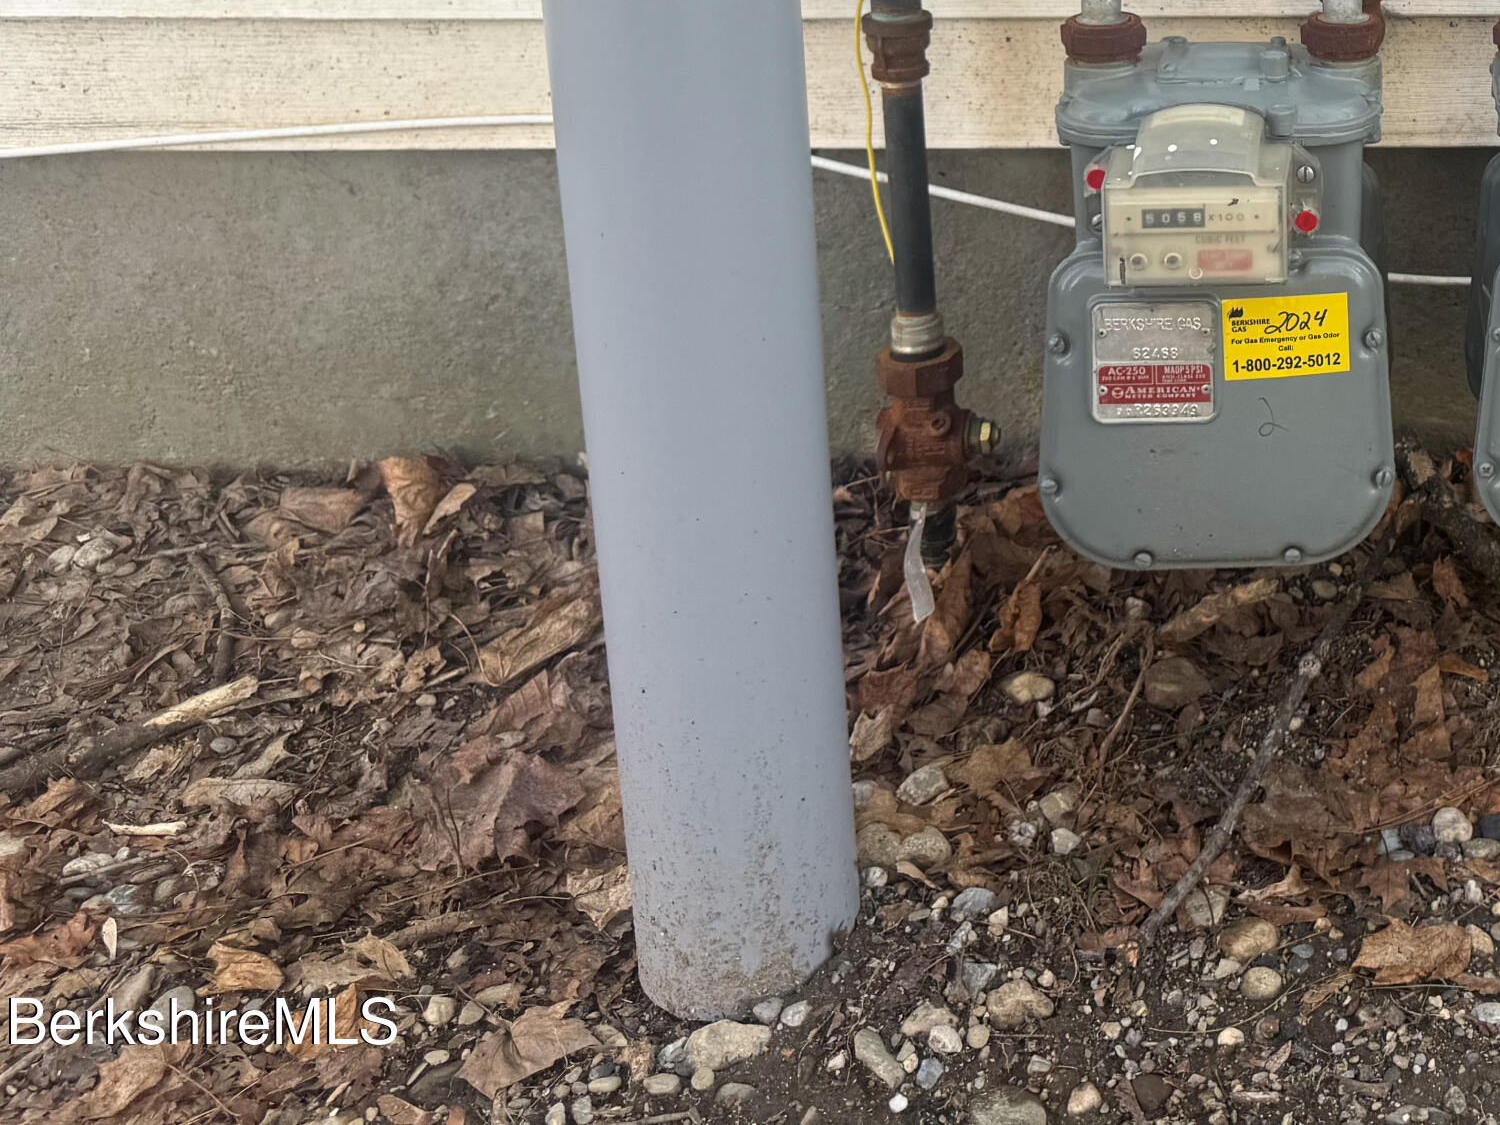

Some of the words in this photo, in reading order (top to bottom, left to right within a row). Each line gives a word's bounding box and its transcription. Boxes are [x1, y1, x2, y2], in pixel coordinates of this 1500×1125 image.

[1195, 235, 1222, 245] CUBIC
[1225, 234, 1246, 244] FEET
[1177, 316, 1202, 331] GAS
[1231, 318, 1271, 327] BERKSHIRE
[1264, 308, 1328, 335] 2024
[1259, 335, 1298, 344] Emergency
[1322, 331, 1340, 339] Odor
[1232, 352, 1341, 373] 1-800-292-5012
[1108, 366, 1146, 376] AC-250
[1125, 386, 1196, 394] AMERICAN
